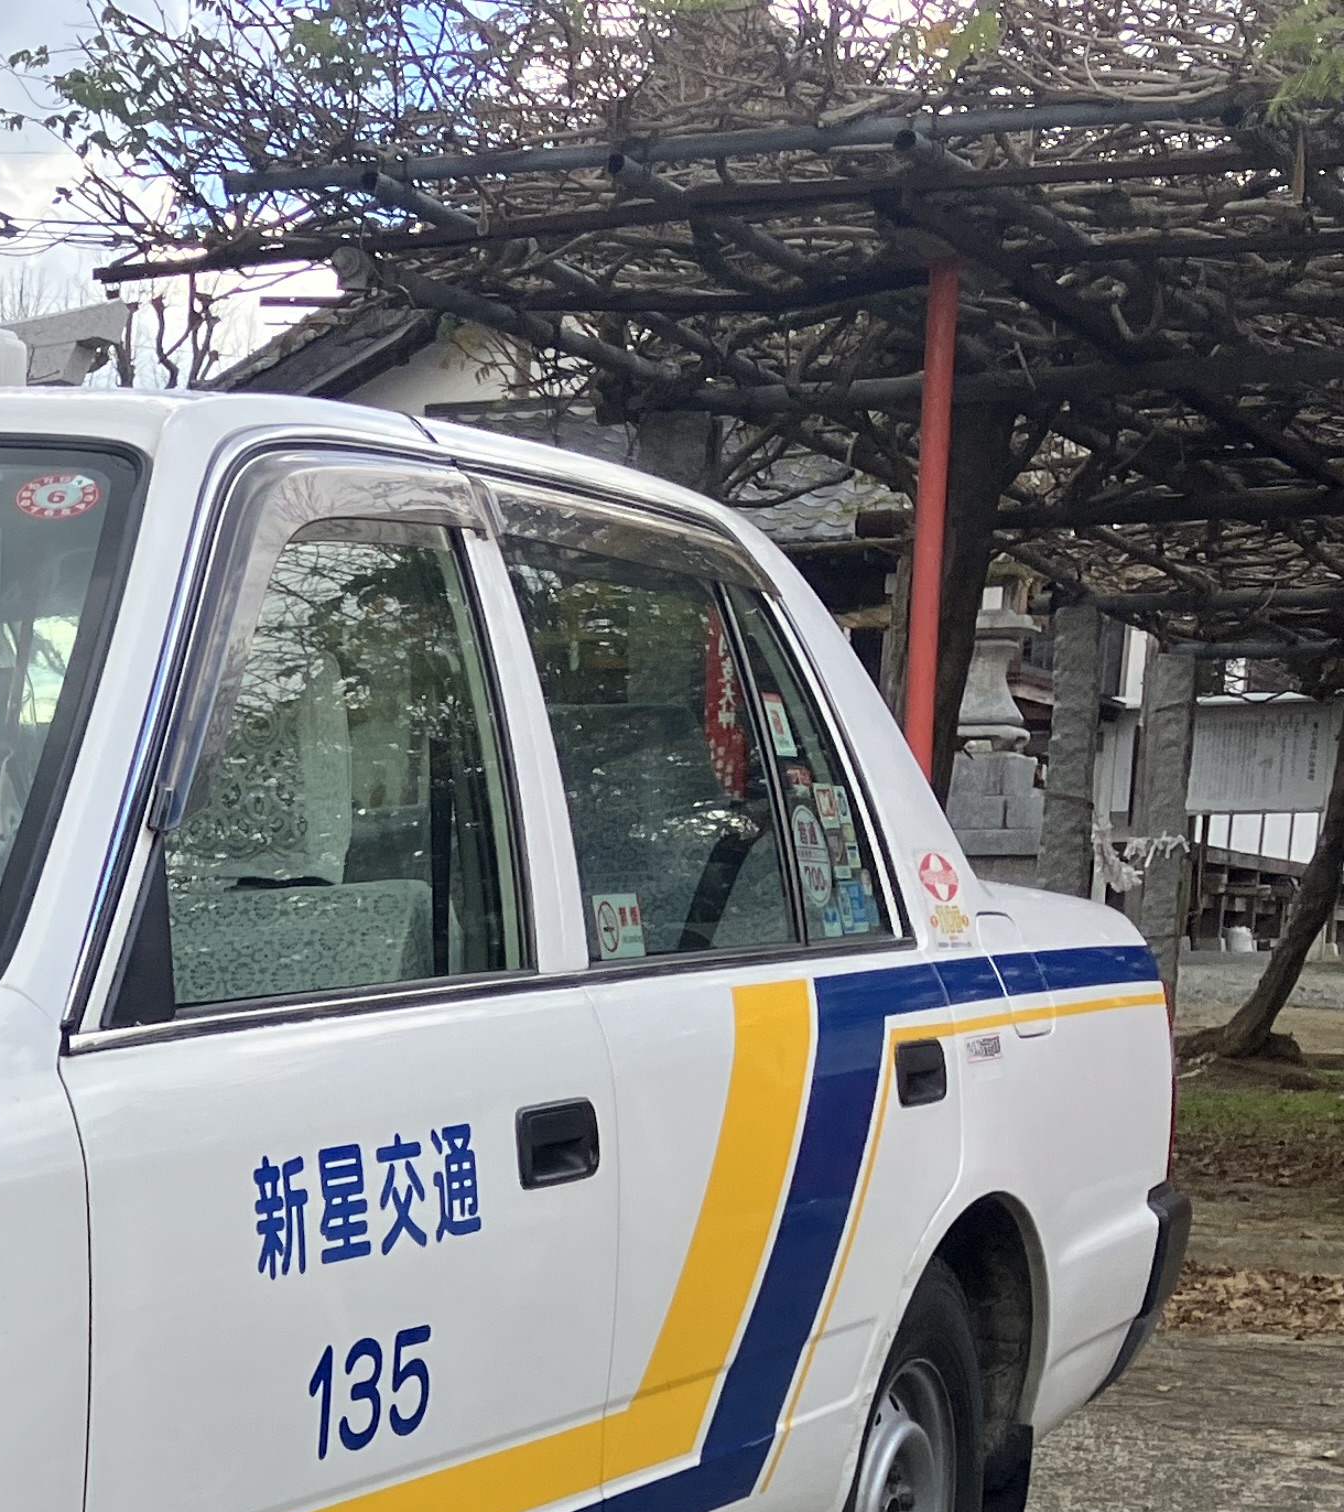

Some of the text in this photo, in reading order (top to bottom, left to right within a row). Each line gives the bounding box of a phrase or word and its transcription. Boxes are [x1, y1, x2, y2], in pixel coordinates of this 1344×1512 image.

[253, 1122, 482, 1280] 新星交通
[309, 1324, 431, 1461] 135
